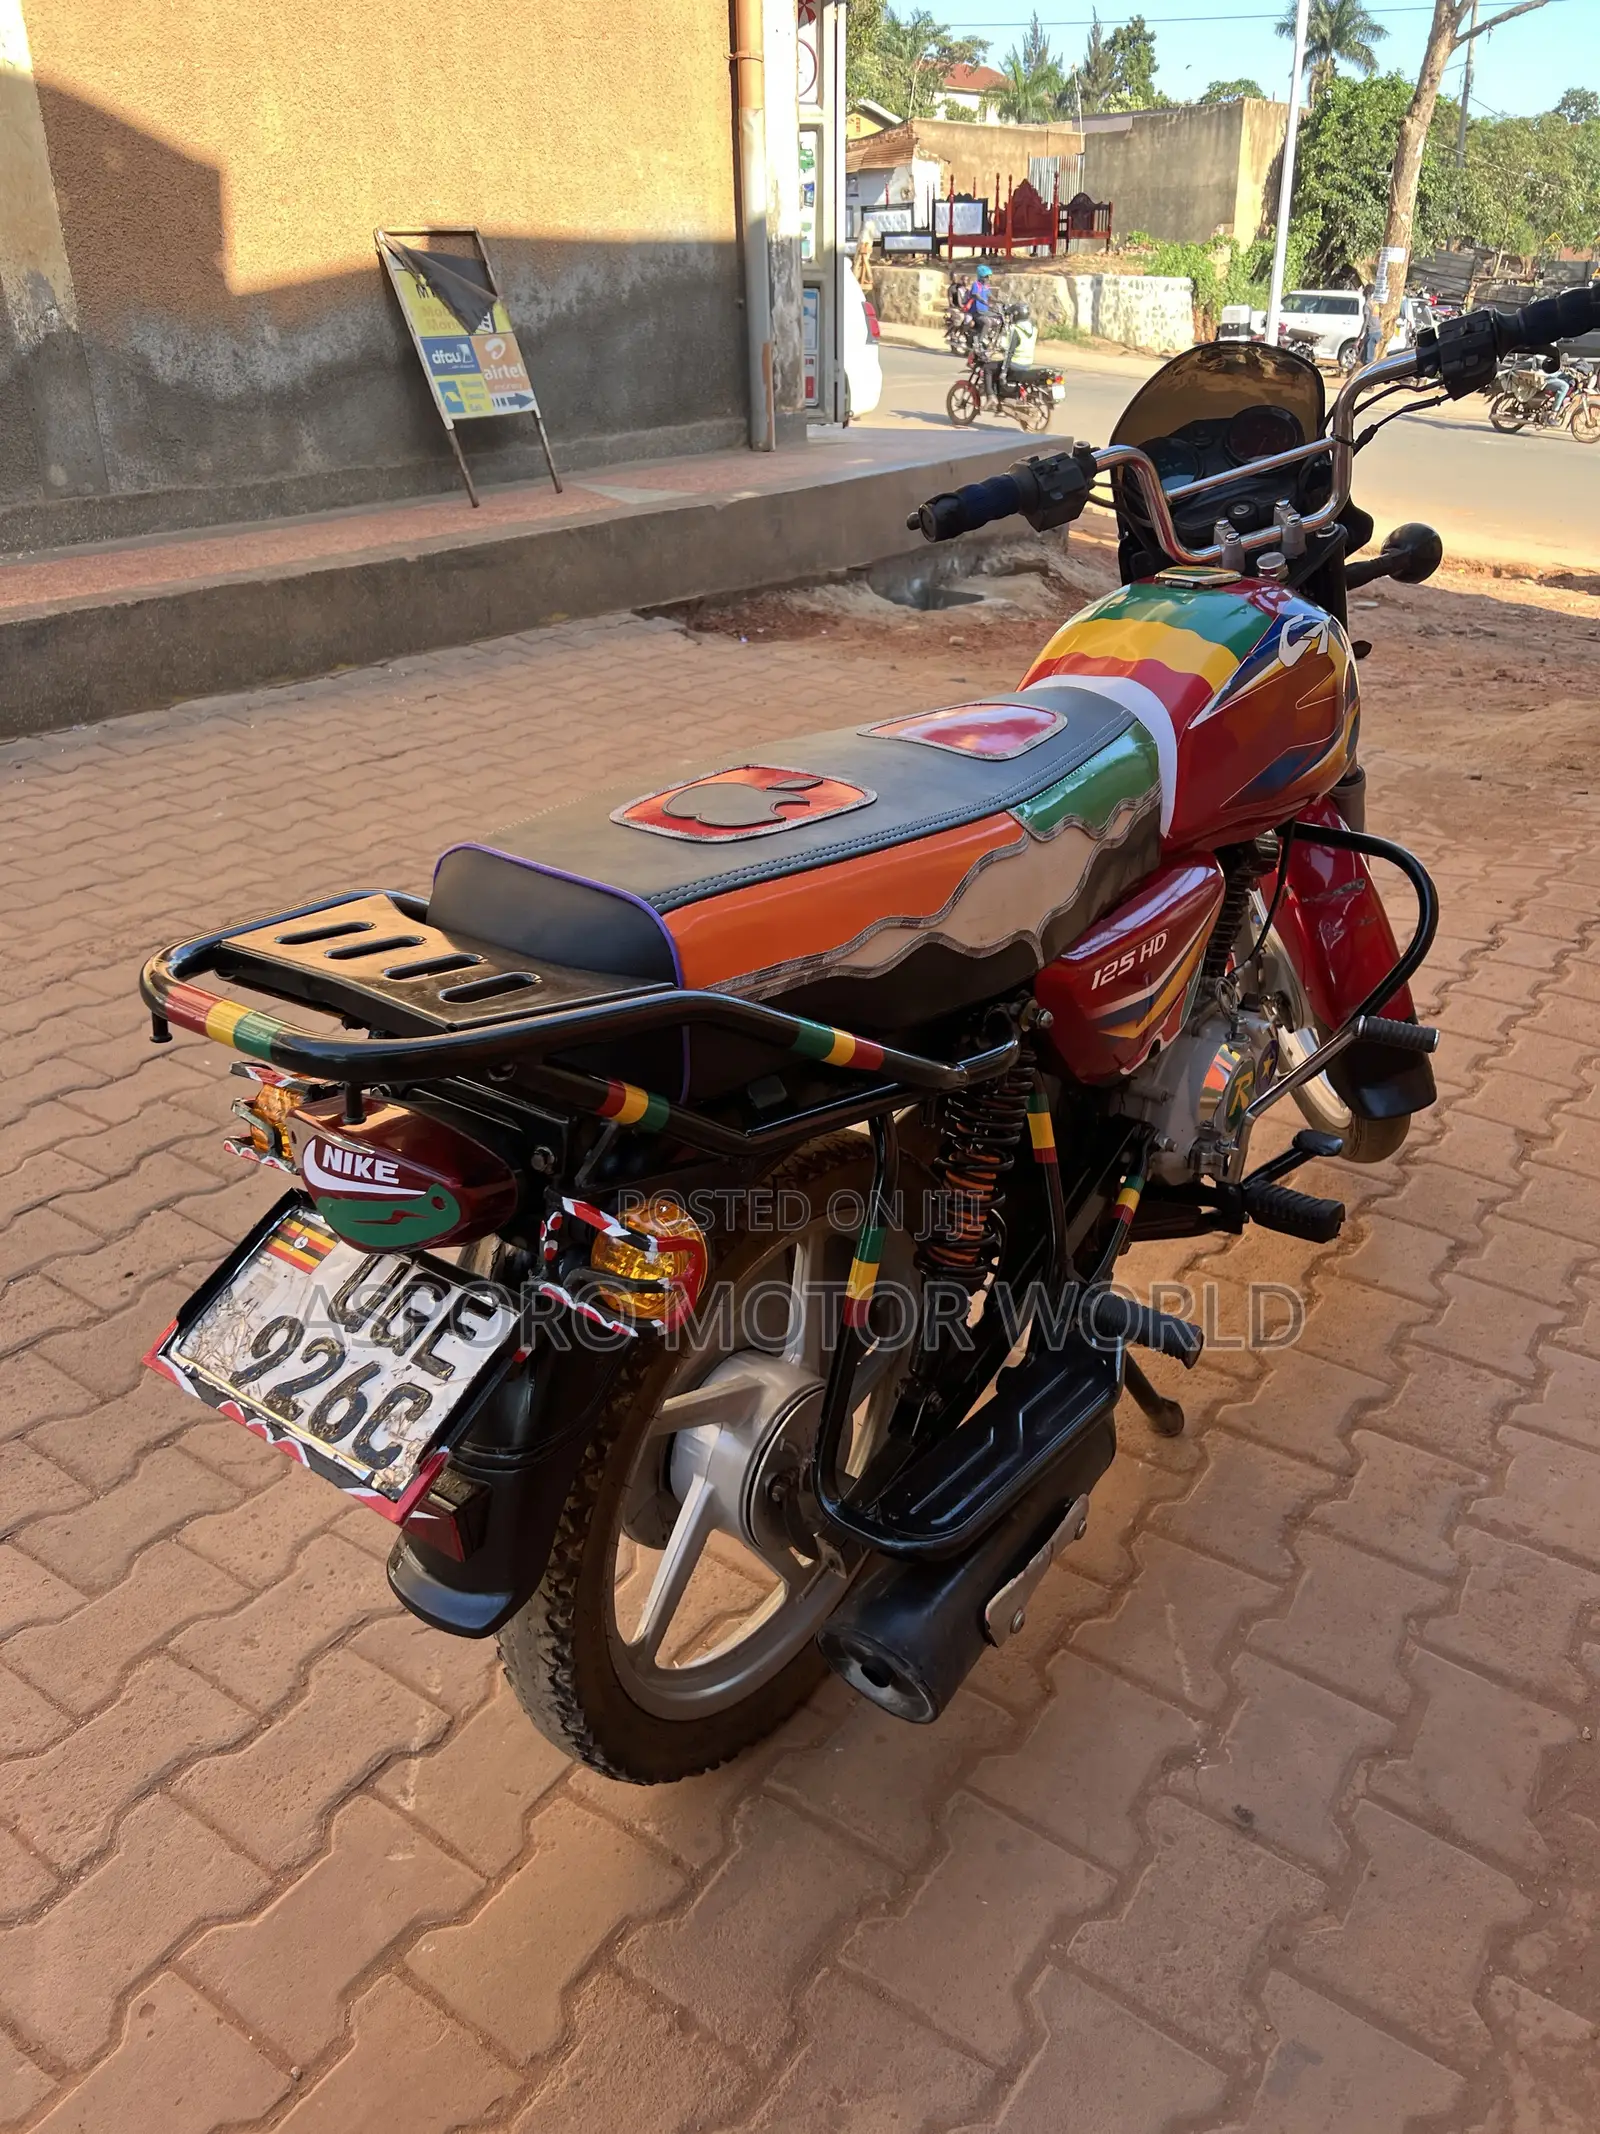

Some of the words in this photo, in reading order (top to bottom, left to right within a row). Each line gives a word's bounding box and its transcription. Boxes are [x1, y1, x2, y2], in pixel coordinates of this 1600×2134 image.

[431, 349, 462, 365] dfcu
[484, 364, 526, 380] airtel
[1091, 950, 1137, 991] 125
[1139, 932, 1167, 964] HD
[1228, 1071, 1254, 1117] R
[322, 1144, 400, 1185] NIKE
[229, 1315, 434, 1470] 926C
